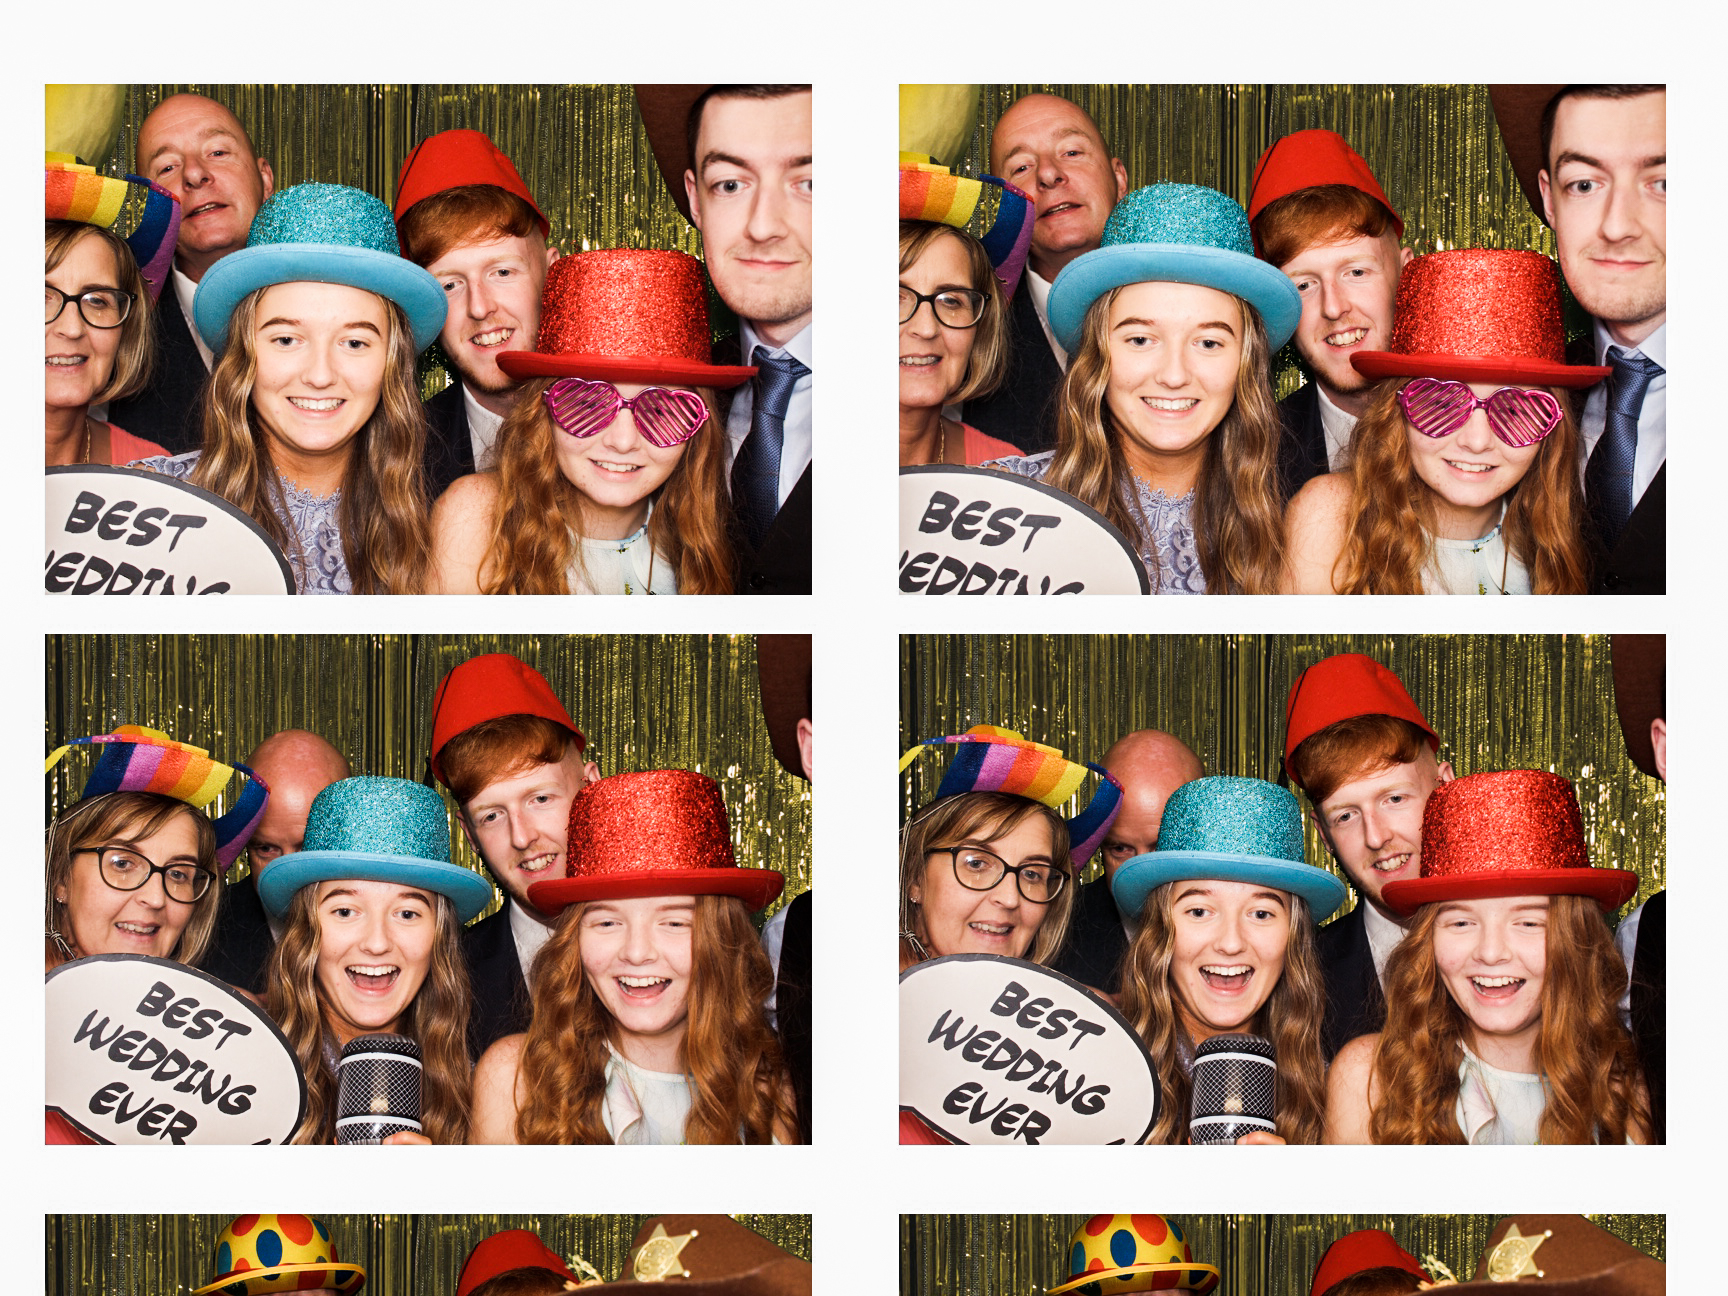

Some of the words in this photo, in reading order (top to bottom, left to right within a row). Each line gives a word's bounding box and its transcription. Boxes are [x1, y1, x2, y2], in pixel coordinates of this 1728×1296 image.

[65, 491, 207, 553] BEST
[919, 491, 1061, 553] BEST
[136, 981, 252, 1051] BEST
[990, 981, 1106, 1051] BEST
[74, 1009, 257, 1116] WEDDING
[928, 1009, 1111, 1116] WEDDING
[89, 1081, 198, 1145] EVER
[943, 1081, 1052, 1145] EVER
